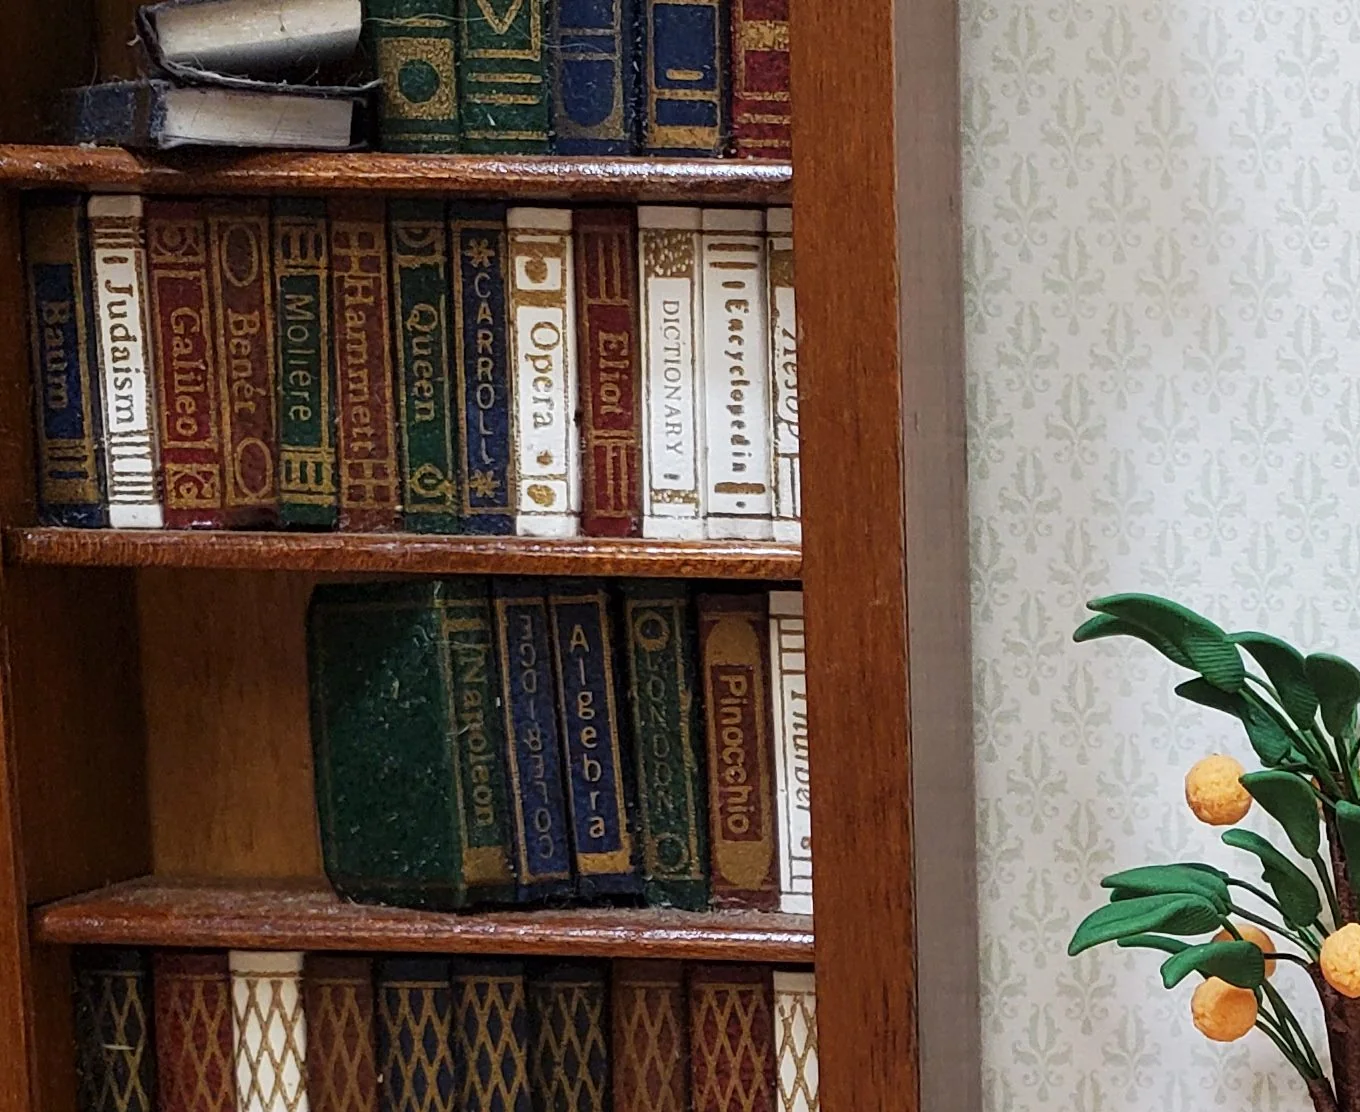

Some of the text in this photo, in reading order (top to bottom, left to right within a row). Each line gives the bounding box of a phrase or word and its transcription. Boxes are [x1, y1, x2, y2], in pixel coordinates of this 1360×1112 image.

[42, 300, 70, 409] Baum
[105, 279, 137, 424] Judaism
[171, 307, 205, 436] Galileo
[345, 277, 377, 452] Hammett
[407, 303, 438, 421] Queen
[474, 272, 496, 464] CARROLL
[525, 321, 560, 429] Opera
[598, 330, 629, 415] Eliot
[663, 300, 685, 457] DICTIONARY
[458, 652, 496, 826] Napoleon
[570, 623, 606, 838] Algebra
[718, 675, 753, 834] Pinocchio
